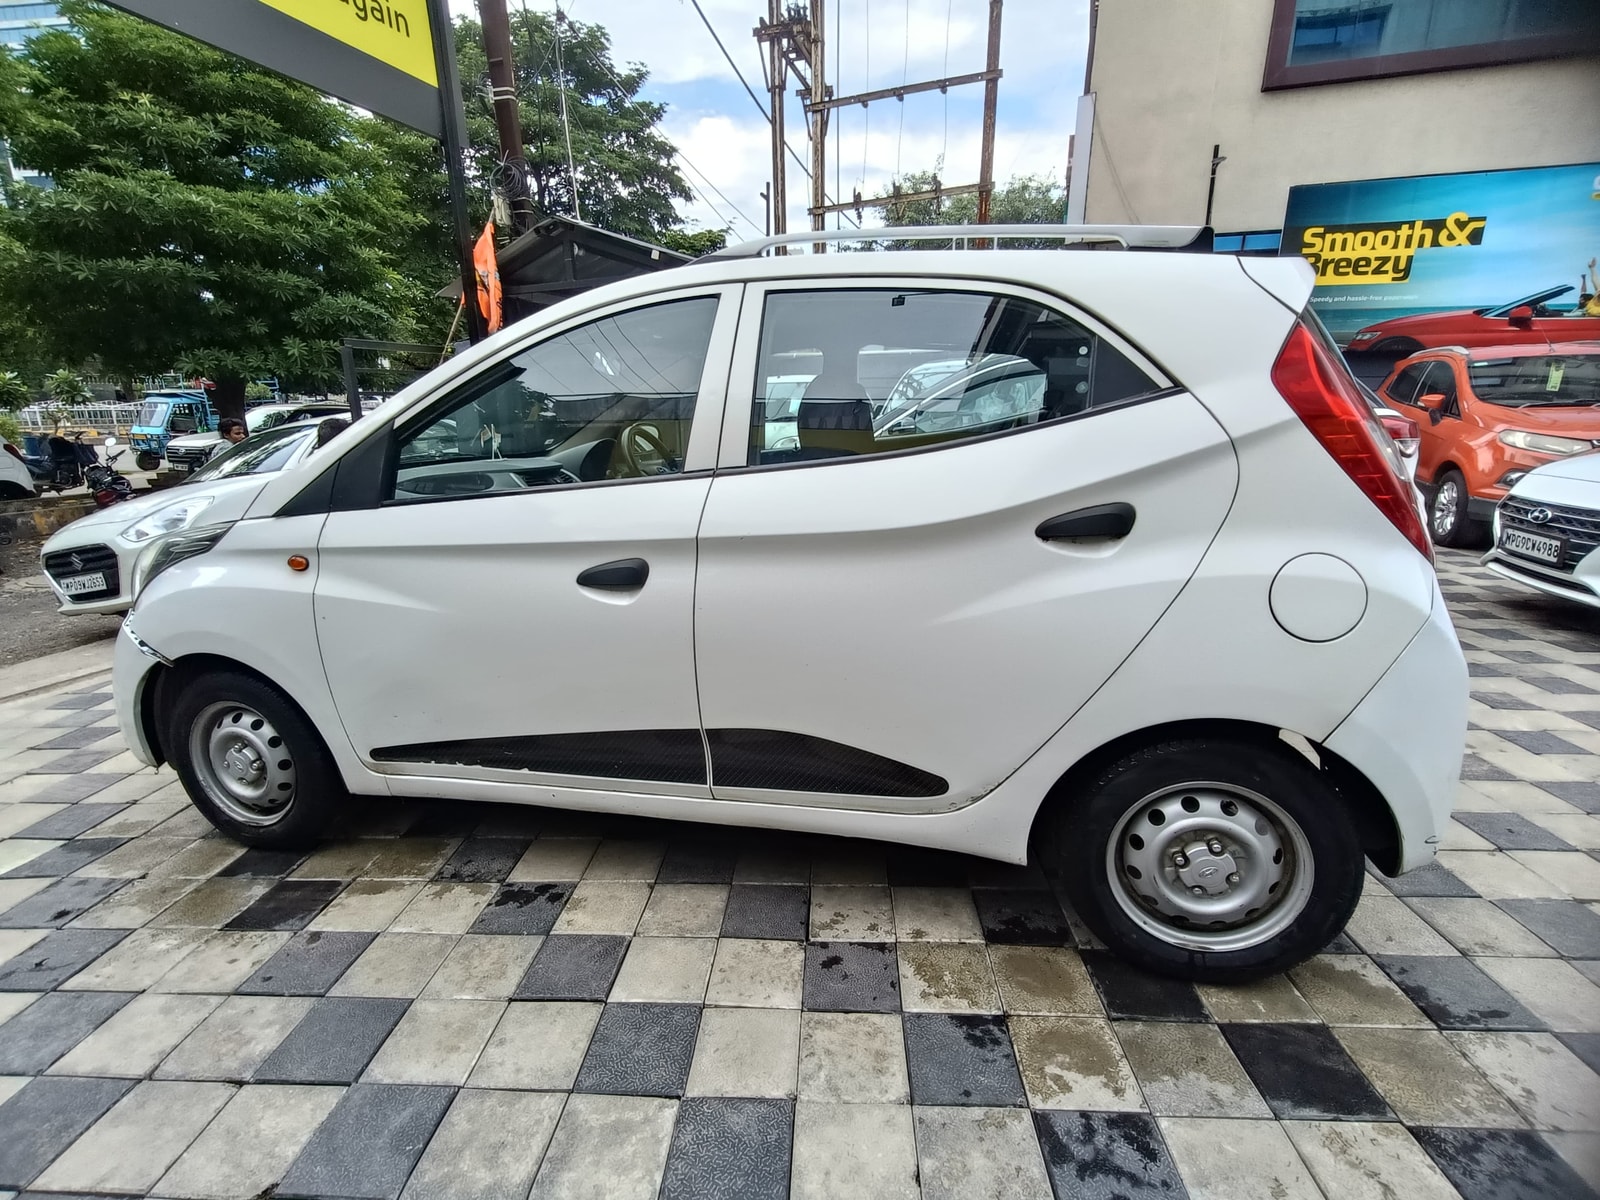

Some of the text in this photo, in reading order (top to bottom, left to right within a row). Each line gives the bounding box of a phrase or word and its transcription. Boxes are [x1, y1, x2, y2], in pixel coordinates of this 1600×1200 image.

[339, 0, 410, 38] gain
[1302, 211, 1487, 254] Smooth &
[1309, 295, 1333, 303] Speedy
